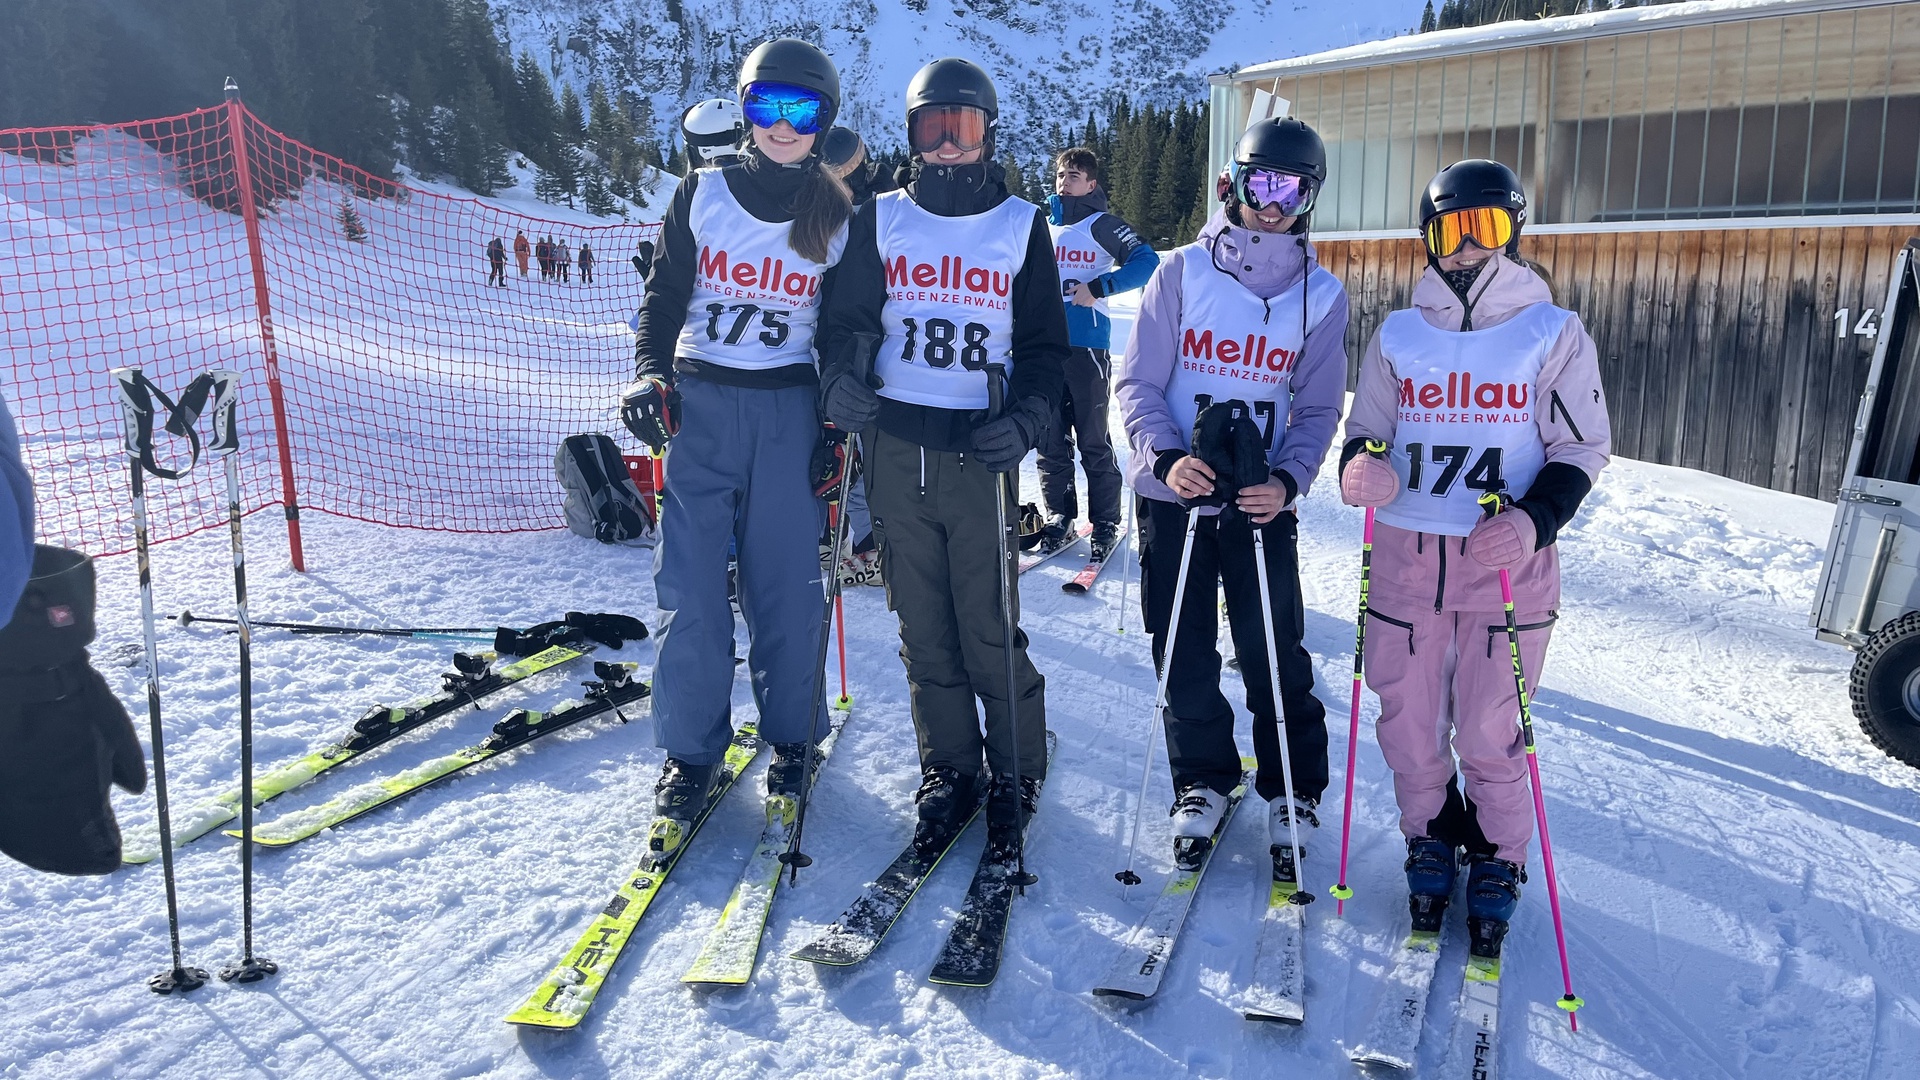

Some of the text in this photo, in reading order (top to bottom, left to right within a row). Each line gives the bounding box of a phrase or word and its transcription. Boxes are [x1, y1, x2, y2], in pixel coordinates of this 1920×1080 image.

[699, 245, 822, 298] Mellau
[885, 255, 1009, 297] Mellau
[1055, 245, 1096, 263] llau
[1057, 262, 1096, 270] ERWALD
[706, 302, 792, 350] 175
[901, 317, 991, 372] 188
[1834, 307, 1885, 339] 14
[1183, 361, 1284, 385] BREGENZERW
[1399, 371, 1528, 409] Mellau
[654, 416, 669, 439] LEKI
[1193, 393, 1278, 453] 17
[1399, 412, 1529, 423] REGENZERWALD
[1405, 442, 1509, 498] 174
[1360, 565, 1371, 611] LEKI
[1518, 677, 1532, 727] LEKI
[542, 926, 621, 1013] HE
